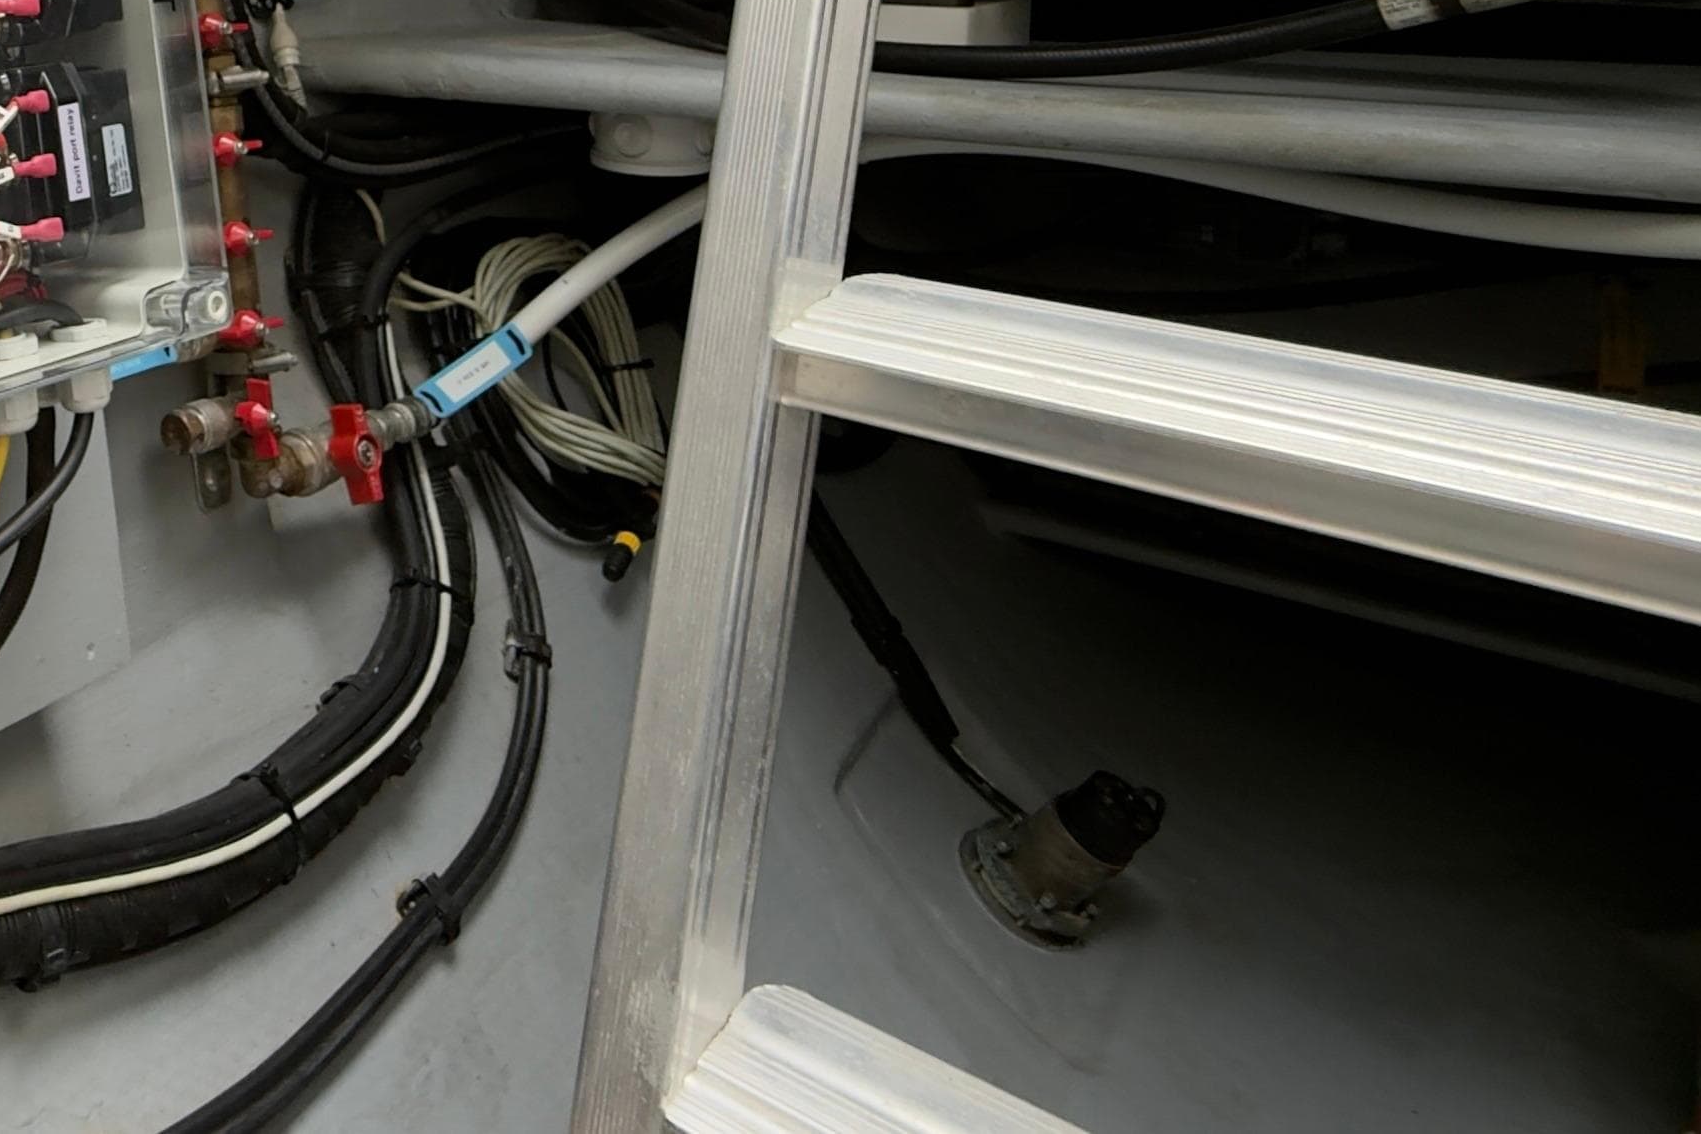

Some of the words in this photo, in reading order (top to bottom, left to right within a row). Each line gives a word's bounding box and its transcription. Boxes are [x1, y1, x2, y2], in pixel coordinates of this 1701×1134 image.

[66, 108, 75, 136] relay
[69, 138, 81, 161] port
[72, 164, 83, 194] Davit
